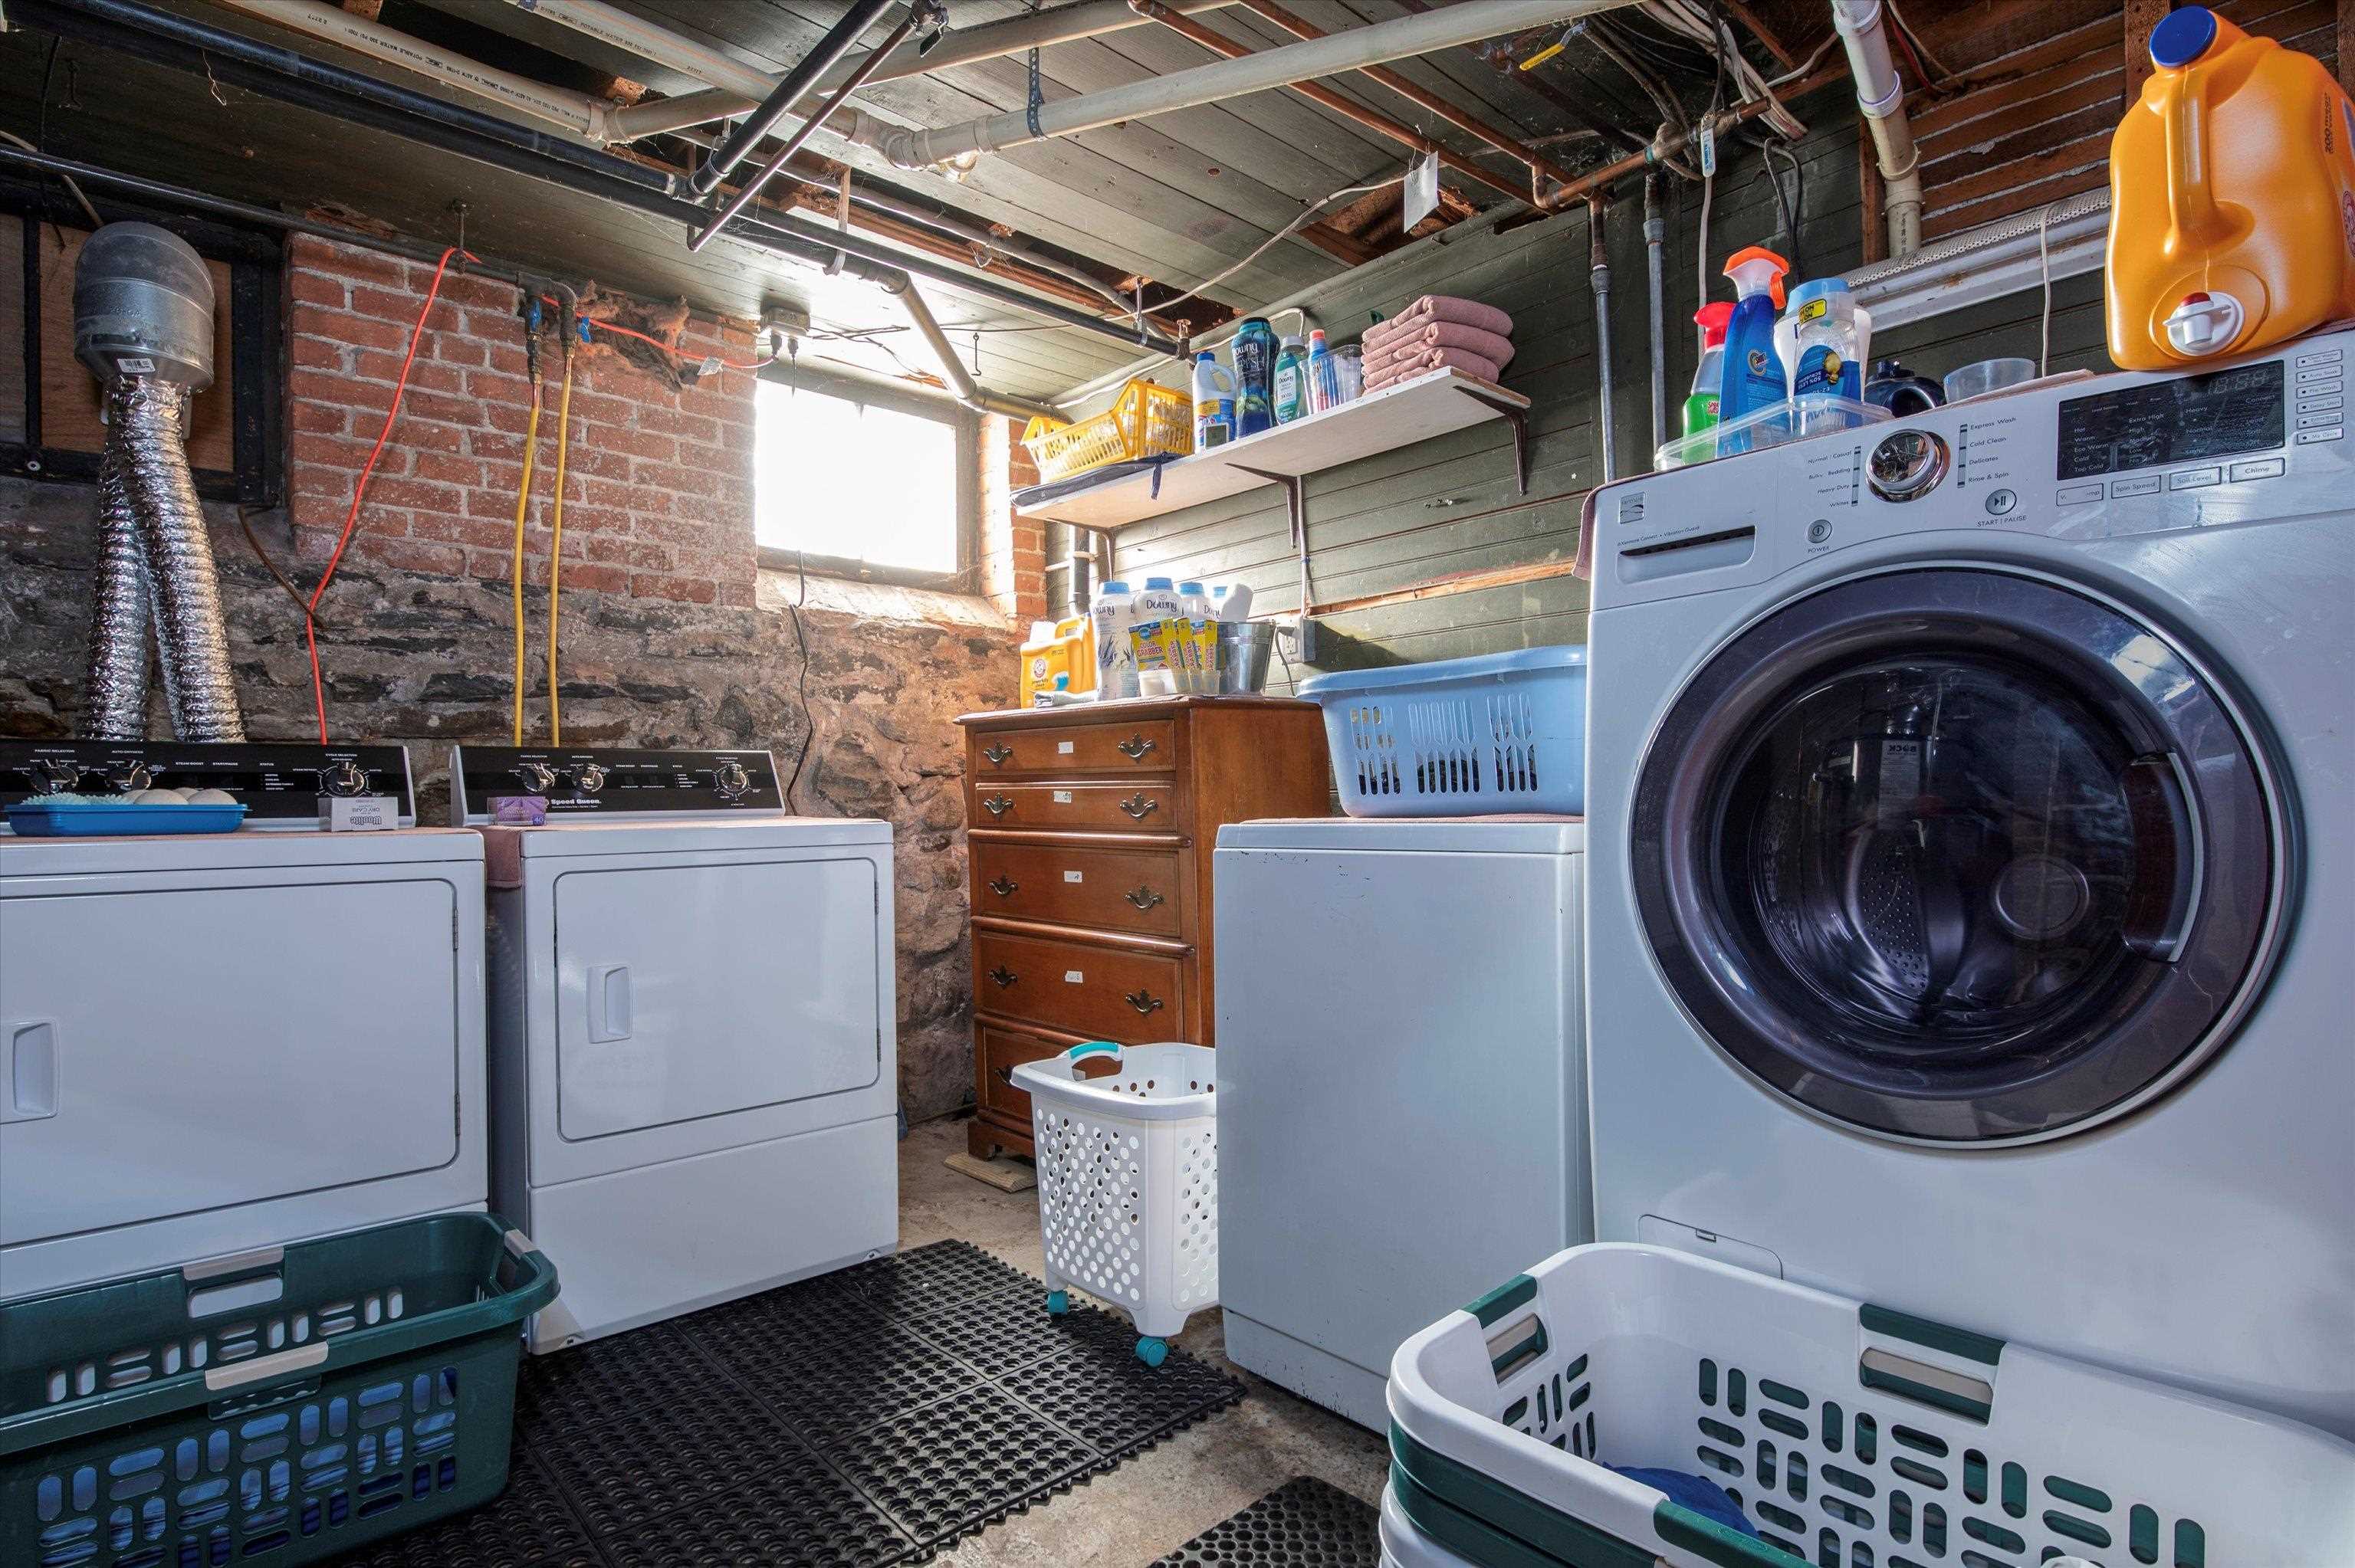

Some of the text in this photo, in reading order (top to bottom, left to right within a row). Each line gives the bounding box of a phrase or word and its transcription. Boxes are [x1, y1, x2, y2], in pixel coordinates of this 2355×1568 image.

[580, 22, 603, 35] POTABLE
[605, 32, 623, 41] WATER
[379, 41, 397, 51] WATER
[399, 47, 422, 61] POTABLE
[2185, 405, 2209, 414] Heavy
[1970, 422, 1995, 431] Express
[2186, 425, 2213, 435] Normal
[1808, 455, 1828, 464] Normal
[1833, 450, 1852, 459] Casual
[1969, 456, 1999, 465] Delicates
[1828, 467, 1851, 476] Bedding
[2192, 474, 2212, 483] Level
[2115, 482, 2156, 493] Spin Speed
[1977, 519, 1999, 527] START
[1664, 529, 1684, 537] Vibration
[1808, 545, 1831, 553] POWER
[1146, 599, 1178, 612] Downy
[1138, 647, 1164, 657] GRABBER
[350, 815, 383, 825] Woolite
